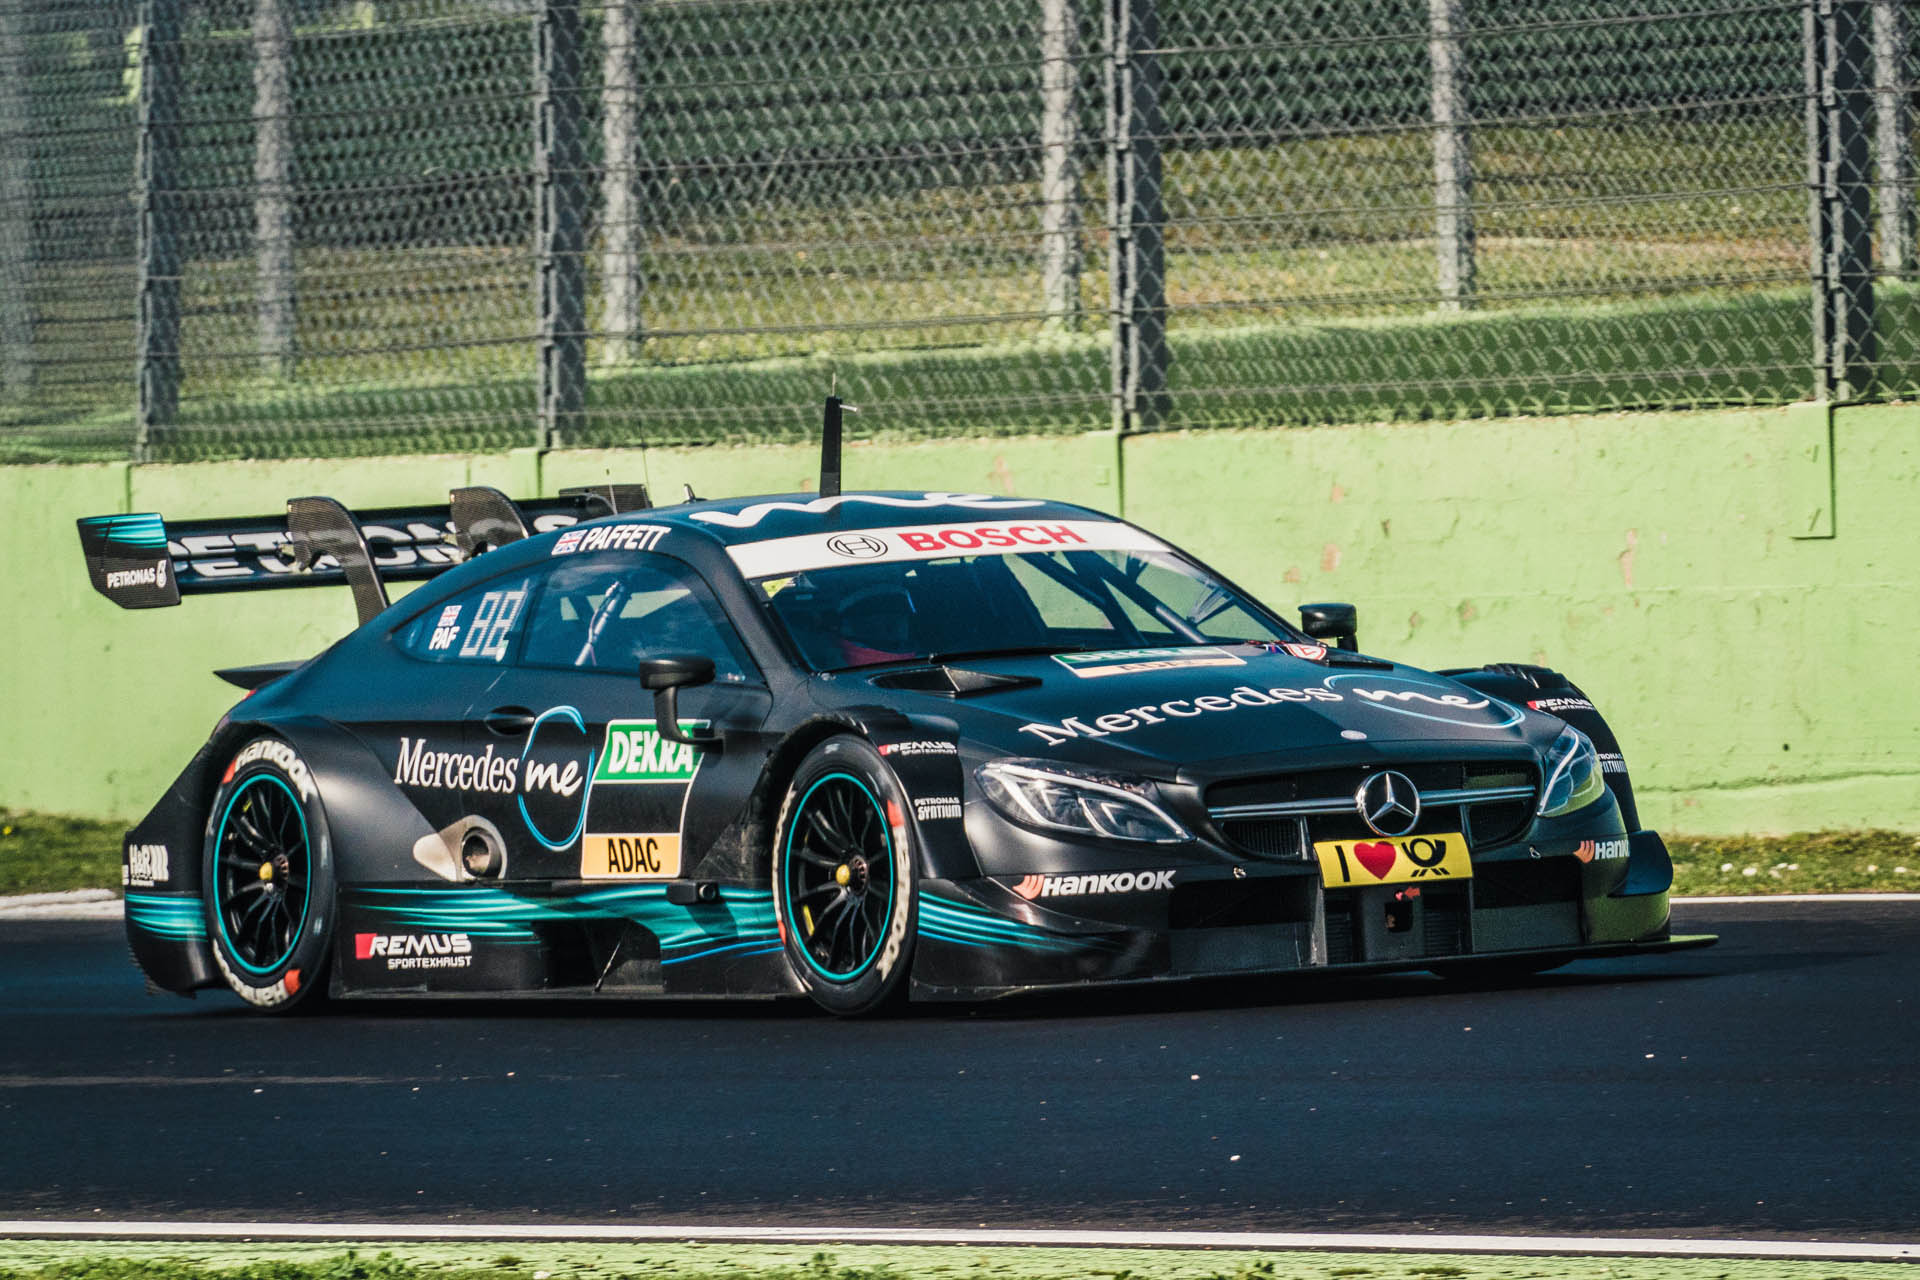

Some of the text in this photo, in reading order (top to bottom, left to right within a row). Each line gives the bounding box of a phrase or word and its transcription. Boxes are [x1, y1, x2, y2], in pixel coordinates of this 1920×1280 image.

[579, 525, 672, 551] PAFFETT
[897, 525, 1087, 552] BOSCH
[106, 567, 155, 589] PETRONAS
[429, 626, 461, 650] PAF
[1019, 686, 1490, 747] Mercedes me
[608, 730, 694, 774] DEKRA
[886, 741, 956, 754] REMUS
[394, 737, 583, 797] Mercedes me
[914, 797, 959, 806] PETRONAS
[918, 804, 961, 821] SYNTIUM
[607, 838, 661, 873] ADAC
[1334, 845, 1351, 883] I
[369, 933, 472, 956] REMUS
[387, 956, 472, 970] SPORTEXHAUST
